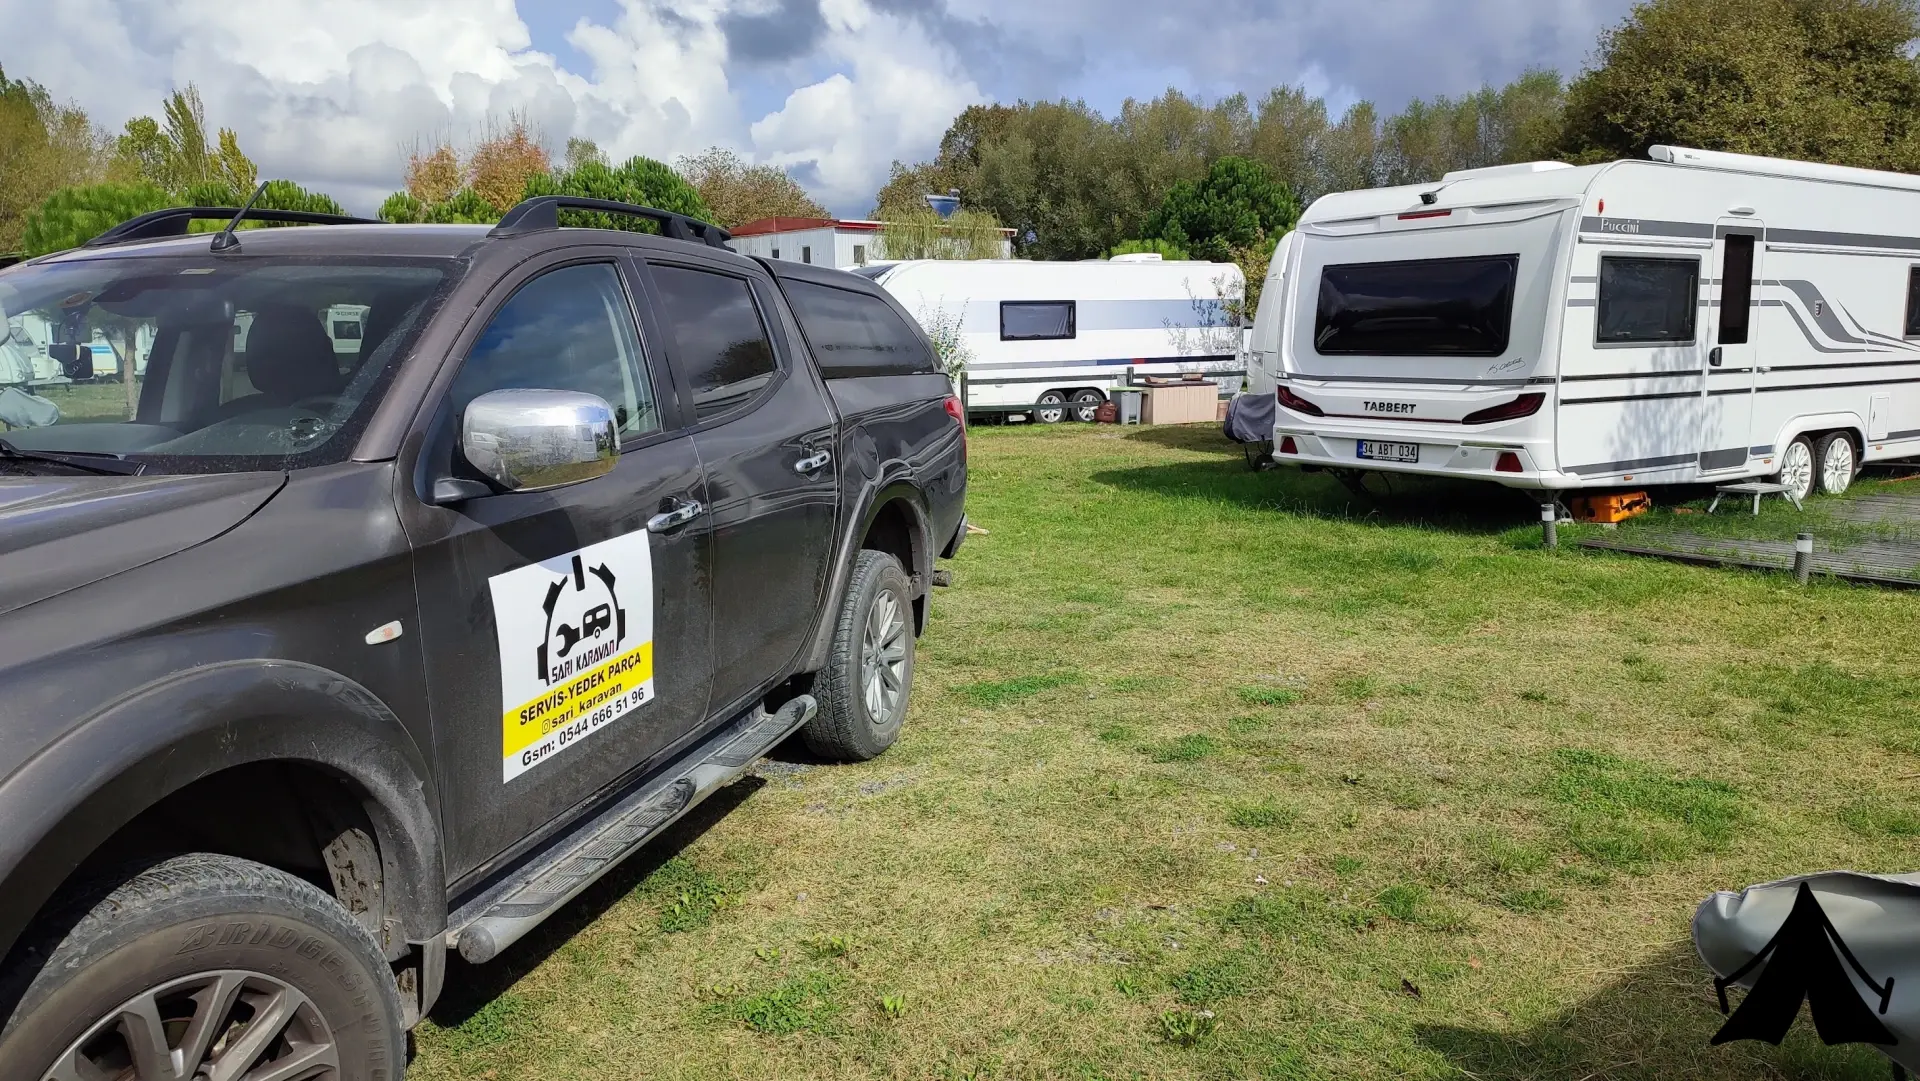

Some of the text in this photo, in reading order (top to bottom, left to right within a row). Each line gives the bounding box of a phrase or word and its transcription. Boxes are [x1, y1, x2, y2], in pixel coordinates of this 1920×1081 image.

[1600, 217, 1640, 234] Puccini
[1363, 400, 1417, 414] TABBERT
[1363, 442, 1416, 458] 34 ABT 034
[552, 638, 615, 684] SARI KARAVAN
[520, 651, 642, 726] SERVİS-YEDEK PARÇA
[551, 682, 622, 729] sari_karavan
[522, 687, 645, 767] Gsm: 0544 666 51 96
